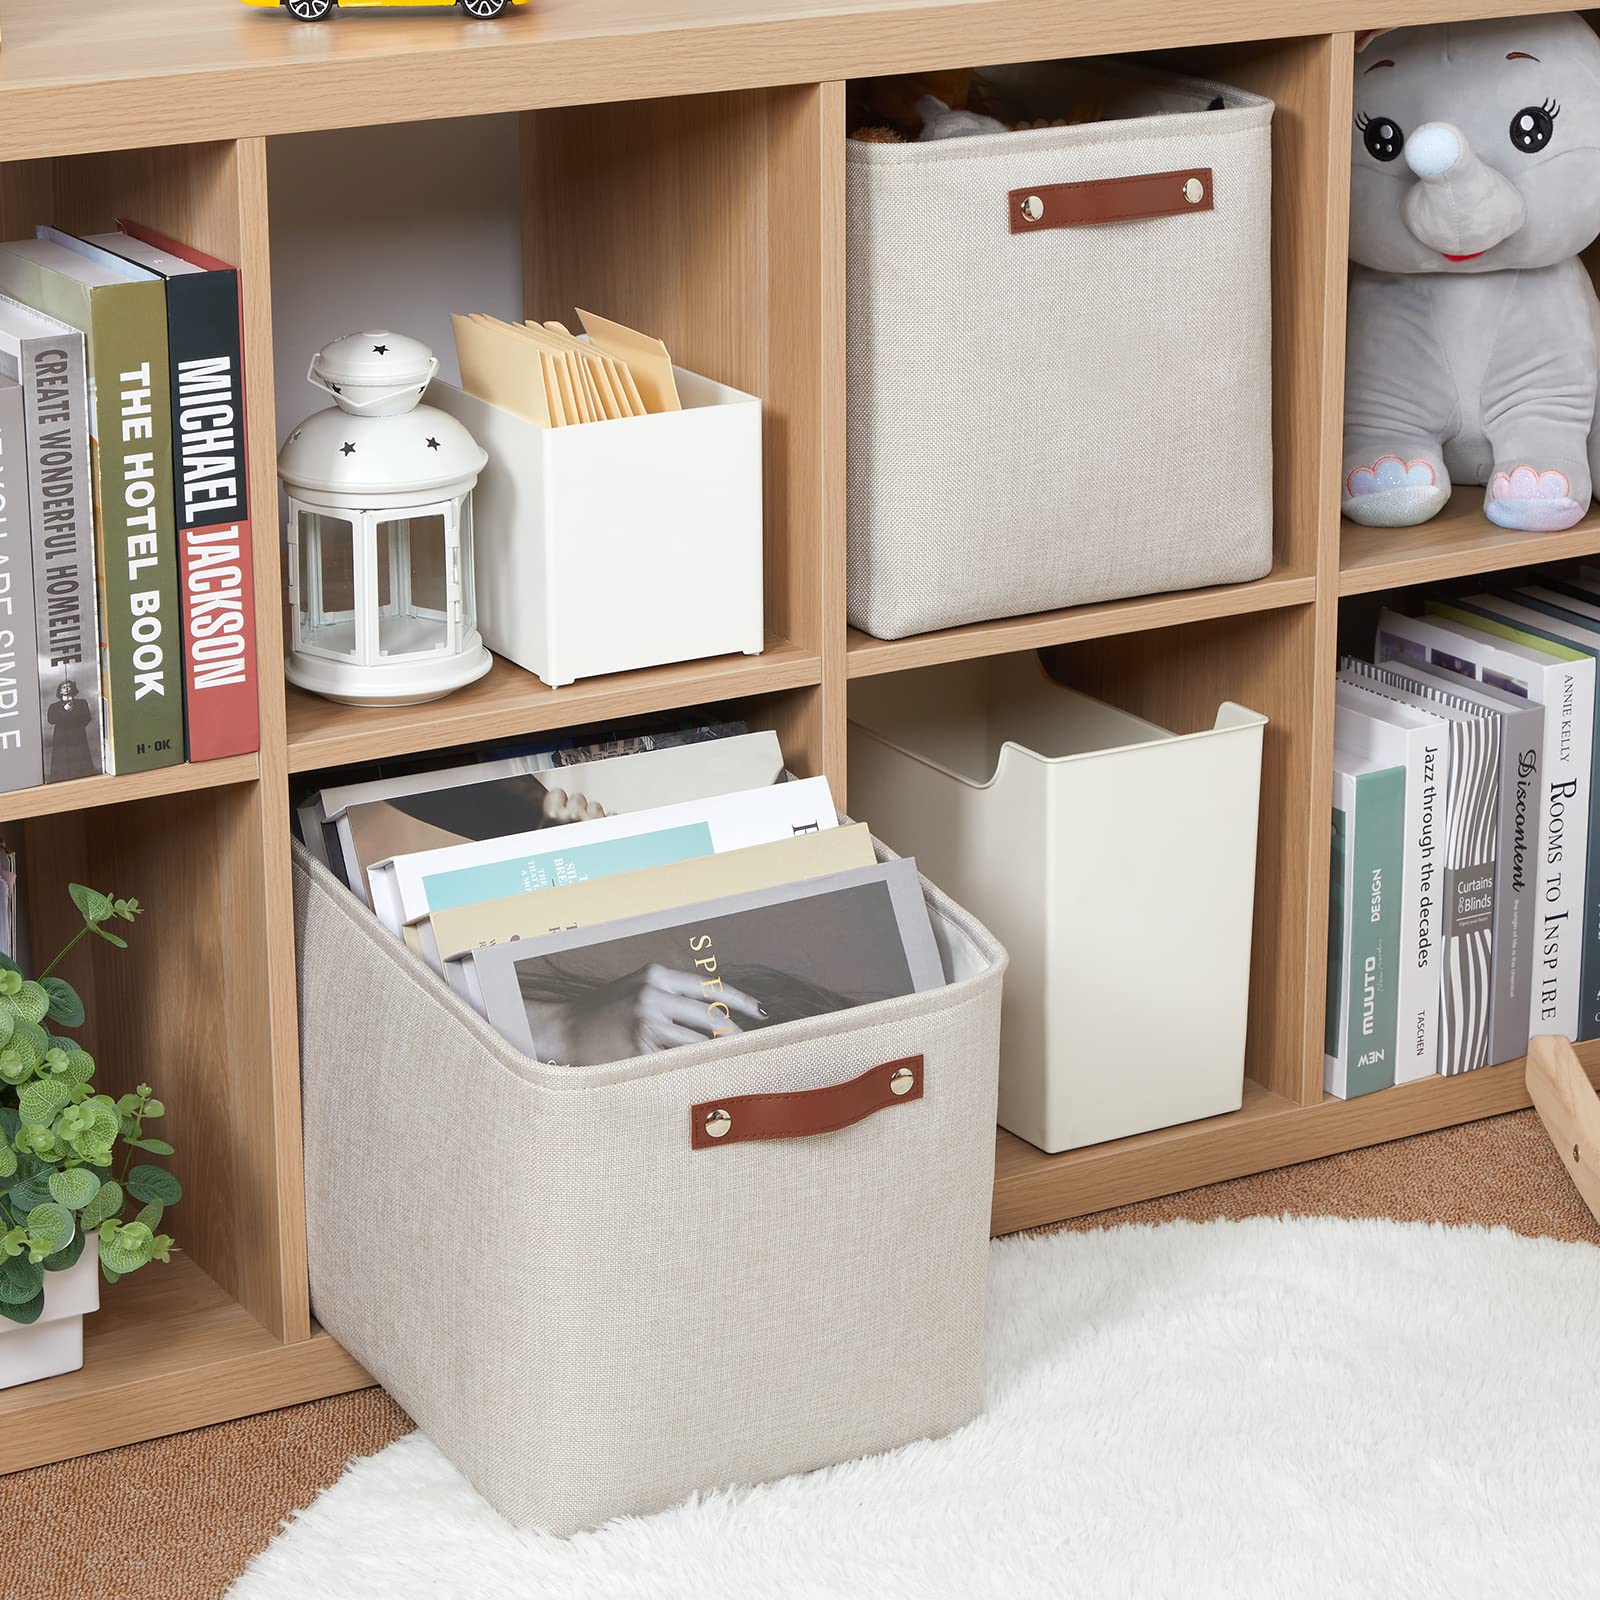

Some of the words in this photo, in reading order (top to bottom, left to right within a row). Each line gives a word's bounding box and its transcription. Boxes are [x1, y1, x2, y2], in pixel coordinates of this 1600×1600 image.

[34, 349, 71, 425] CREATE
[119, 361, 153, 442] THE
[177, 356, 238, 523] MICHAEL
[39, 428, 77, 560] WONDERFUL
[123, 452, 159, 581] HOTEL
[46, 564, 82, 668] HOMELIFE
[186, 525, 247, 690] JACKSON
[130, 589, 165, 701] BOOK
[1563, 674, 1574, 717] ANNIE
[1424, 746, 1438, 783] Jazz
[1560, 720, 1572, 763] KELLY
[1418, 785, 1437, 859] through
[1512, 749, 1537, 893] Discontent
[1371, 868, 1382, 923] DESIGN
[1420, 862, 1434, 892] the
[1457, 877, 1493, 894] Curtains
[1418, 896, 1433, 968] decades
[1357, 1049, 1385, 1068] NEW
[1416, 1010, 1426, 1056] TASCHEN
